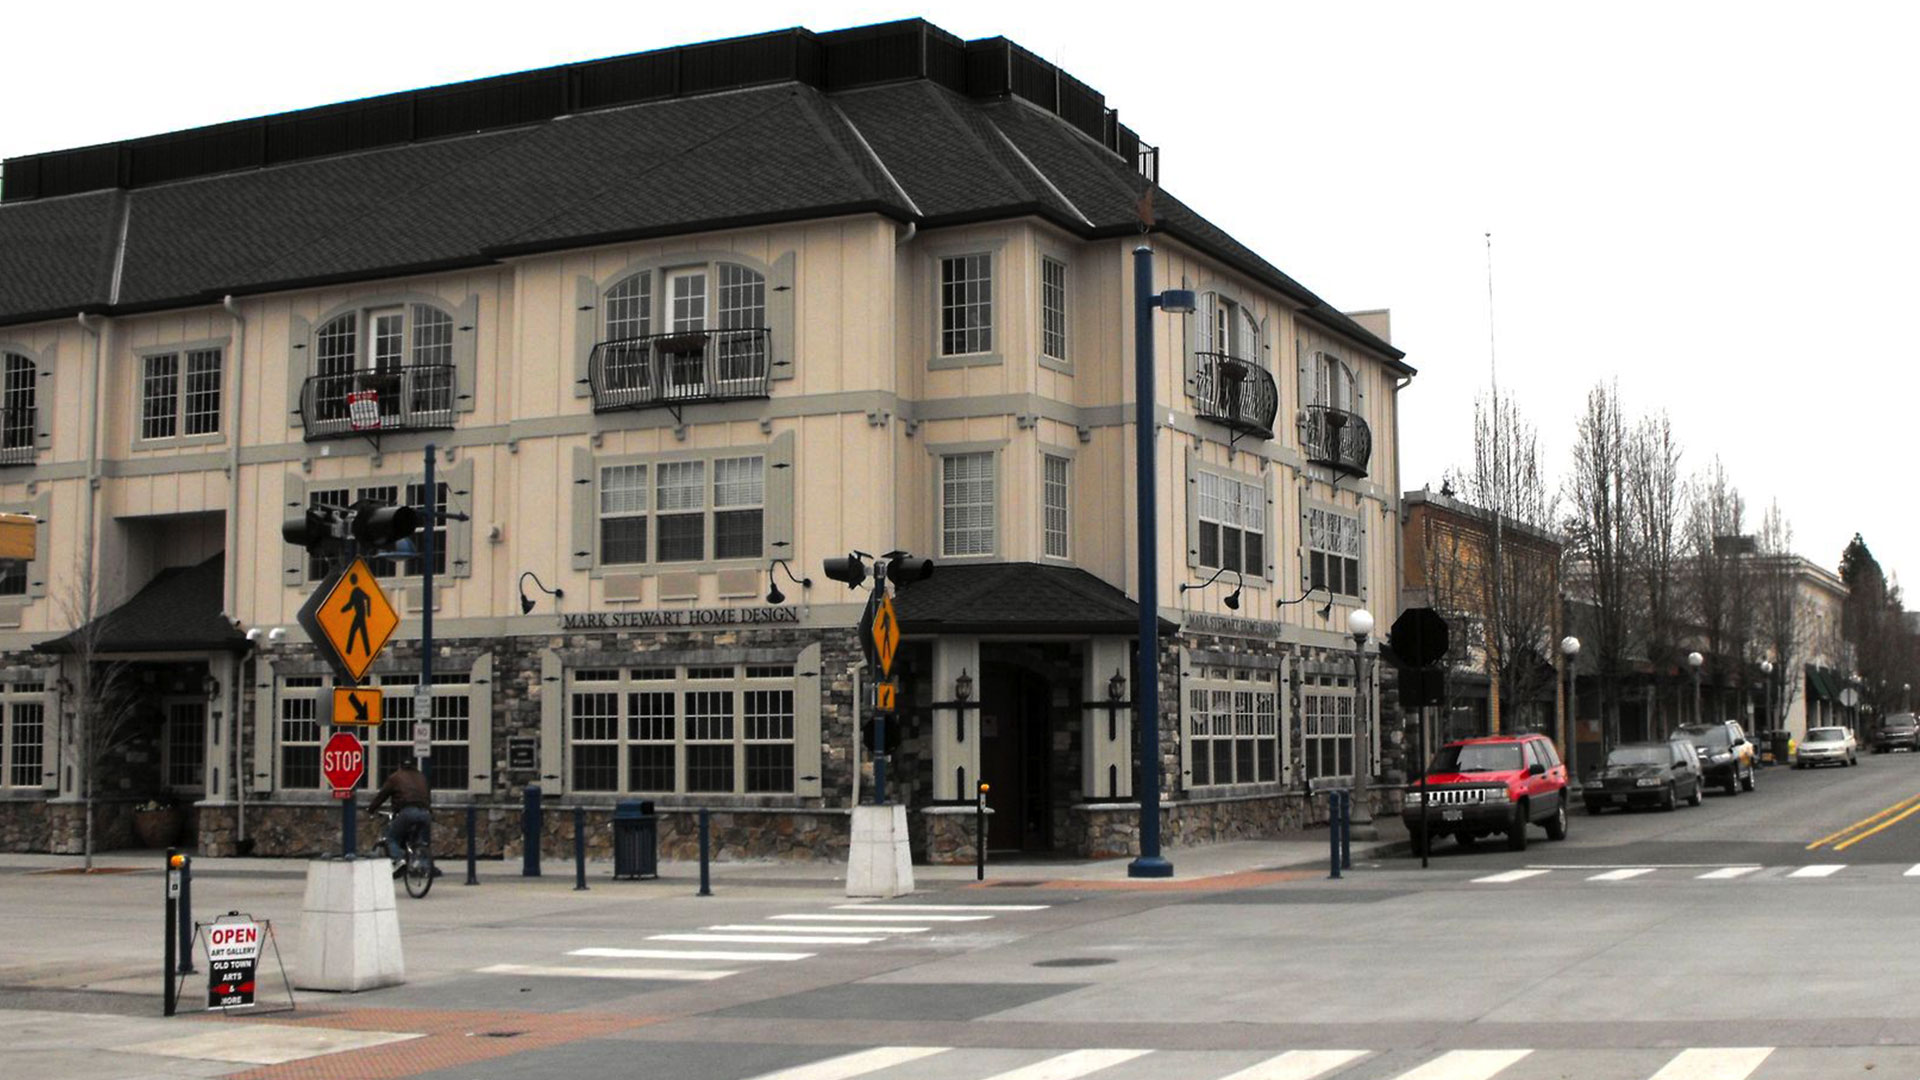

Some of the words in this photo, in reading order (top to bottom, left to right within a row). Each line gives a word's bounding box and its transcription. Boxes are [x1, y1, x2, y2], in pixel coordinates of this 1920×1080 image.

[564, 613, 607, 629] MARK
[612, 611, 683, 627] STEWART
[689, 609, 735, 624] HOME
[325, 751, 361, 771] STOP
[212, 928, 257, 945] OPEN
[211, 949, 225, 957] ART
[226, 947, 256, 956] GALLERY
[213, 962, 230, 971] OLD
[230, 961, 252, 969] TOWN
[223, 973, 242, 982] ARTS
[229, 985, 235, 993] &
[221, 996, 242, 1005] MORE
